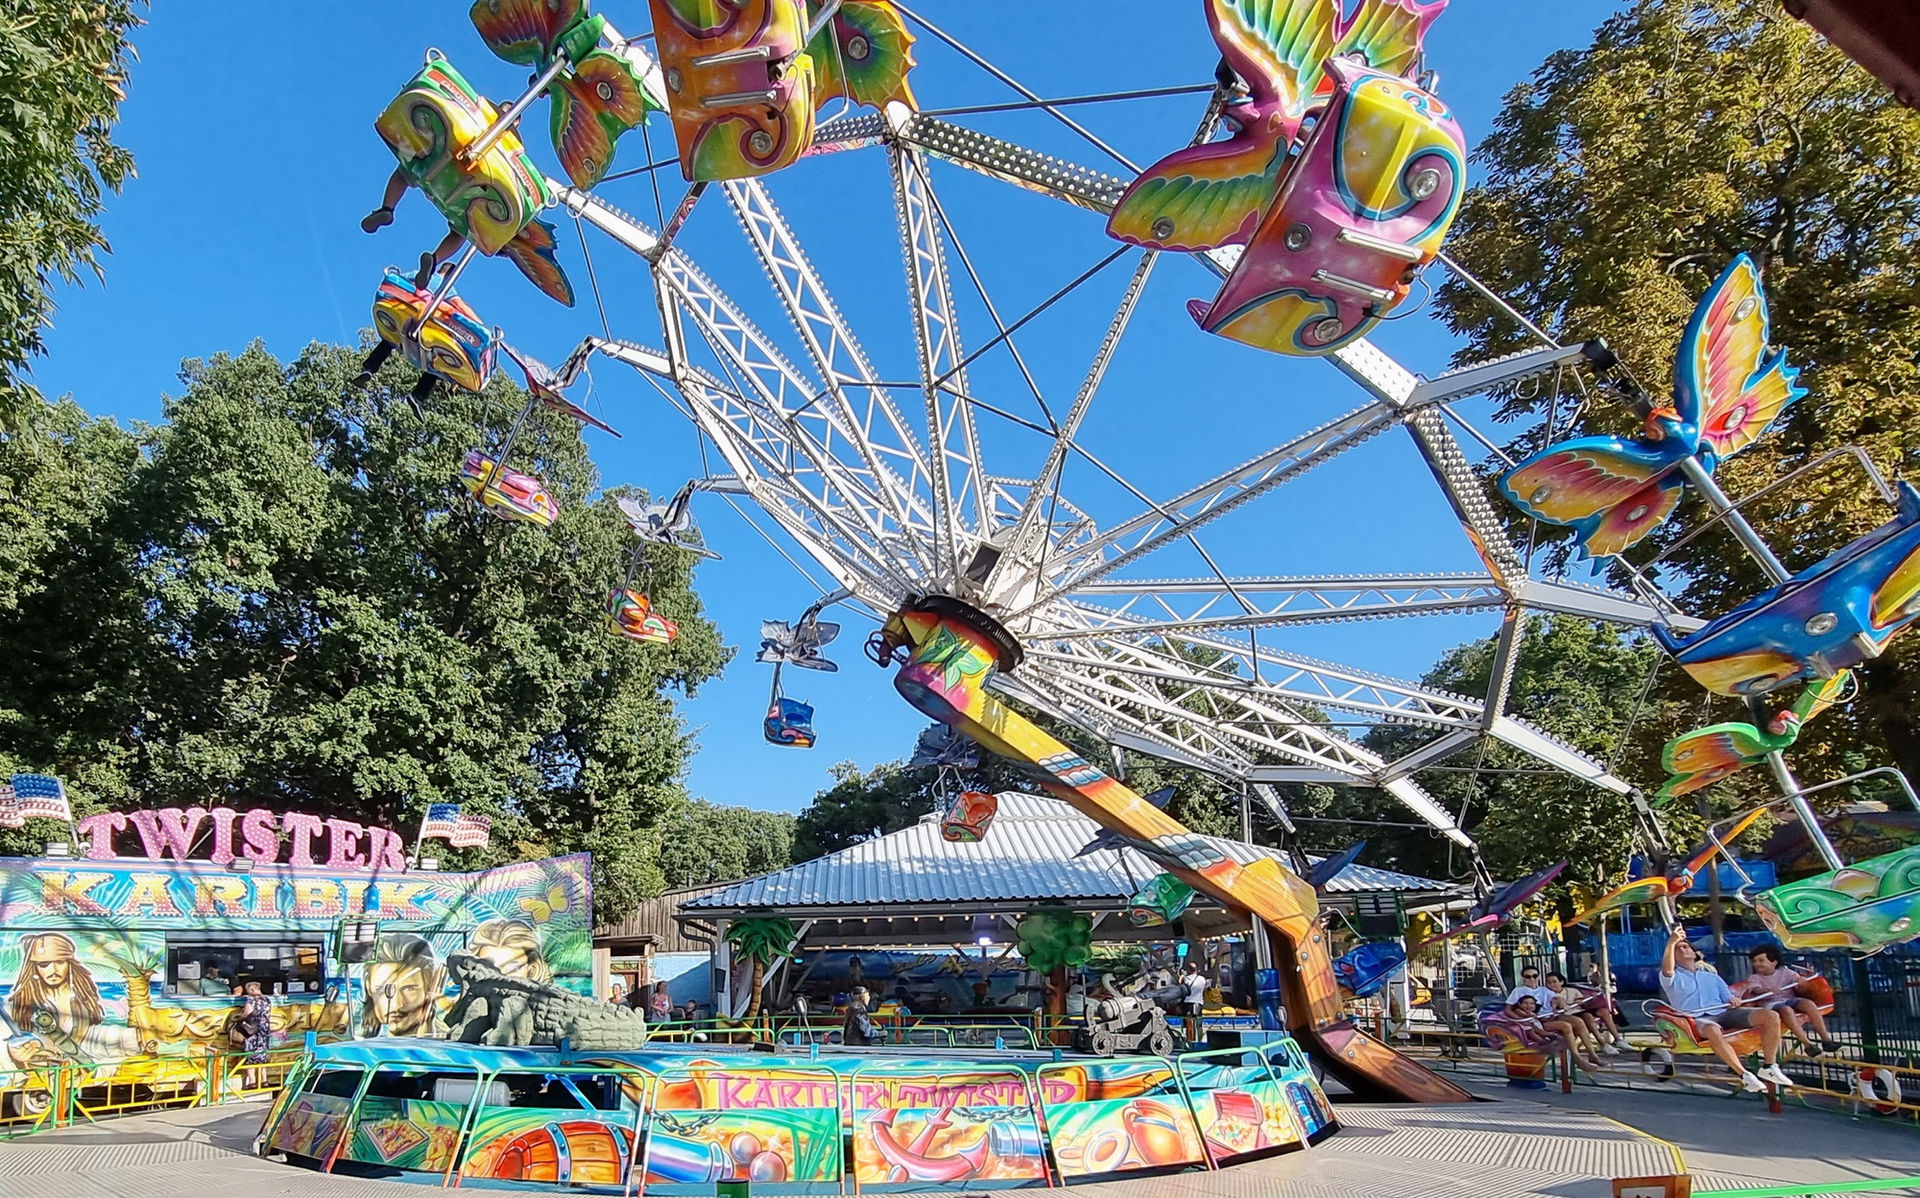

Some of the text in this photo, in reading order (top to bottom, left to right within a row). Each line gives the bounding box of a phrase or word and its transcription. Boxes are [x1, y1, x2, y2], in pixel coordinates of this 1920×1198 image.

[78, 807, 406, 871] TWISTER
[36, 872, 432, 920] KARIBIK
[166, 1008, 313, 1038] KASA
